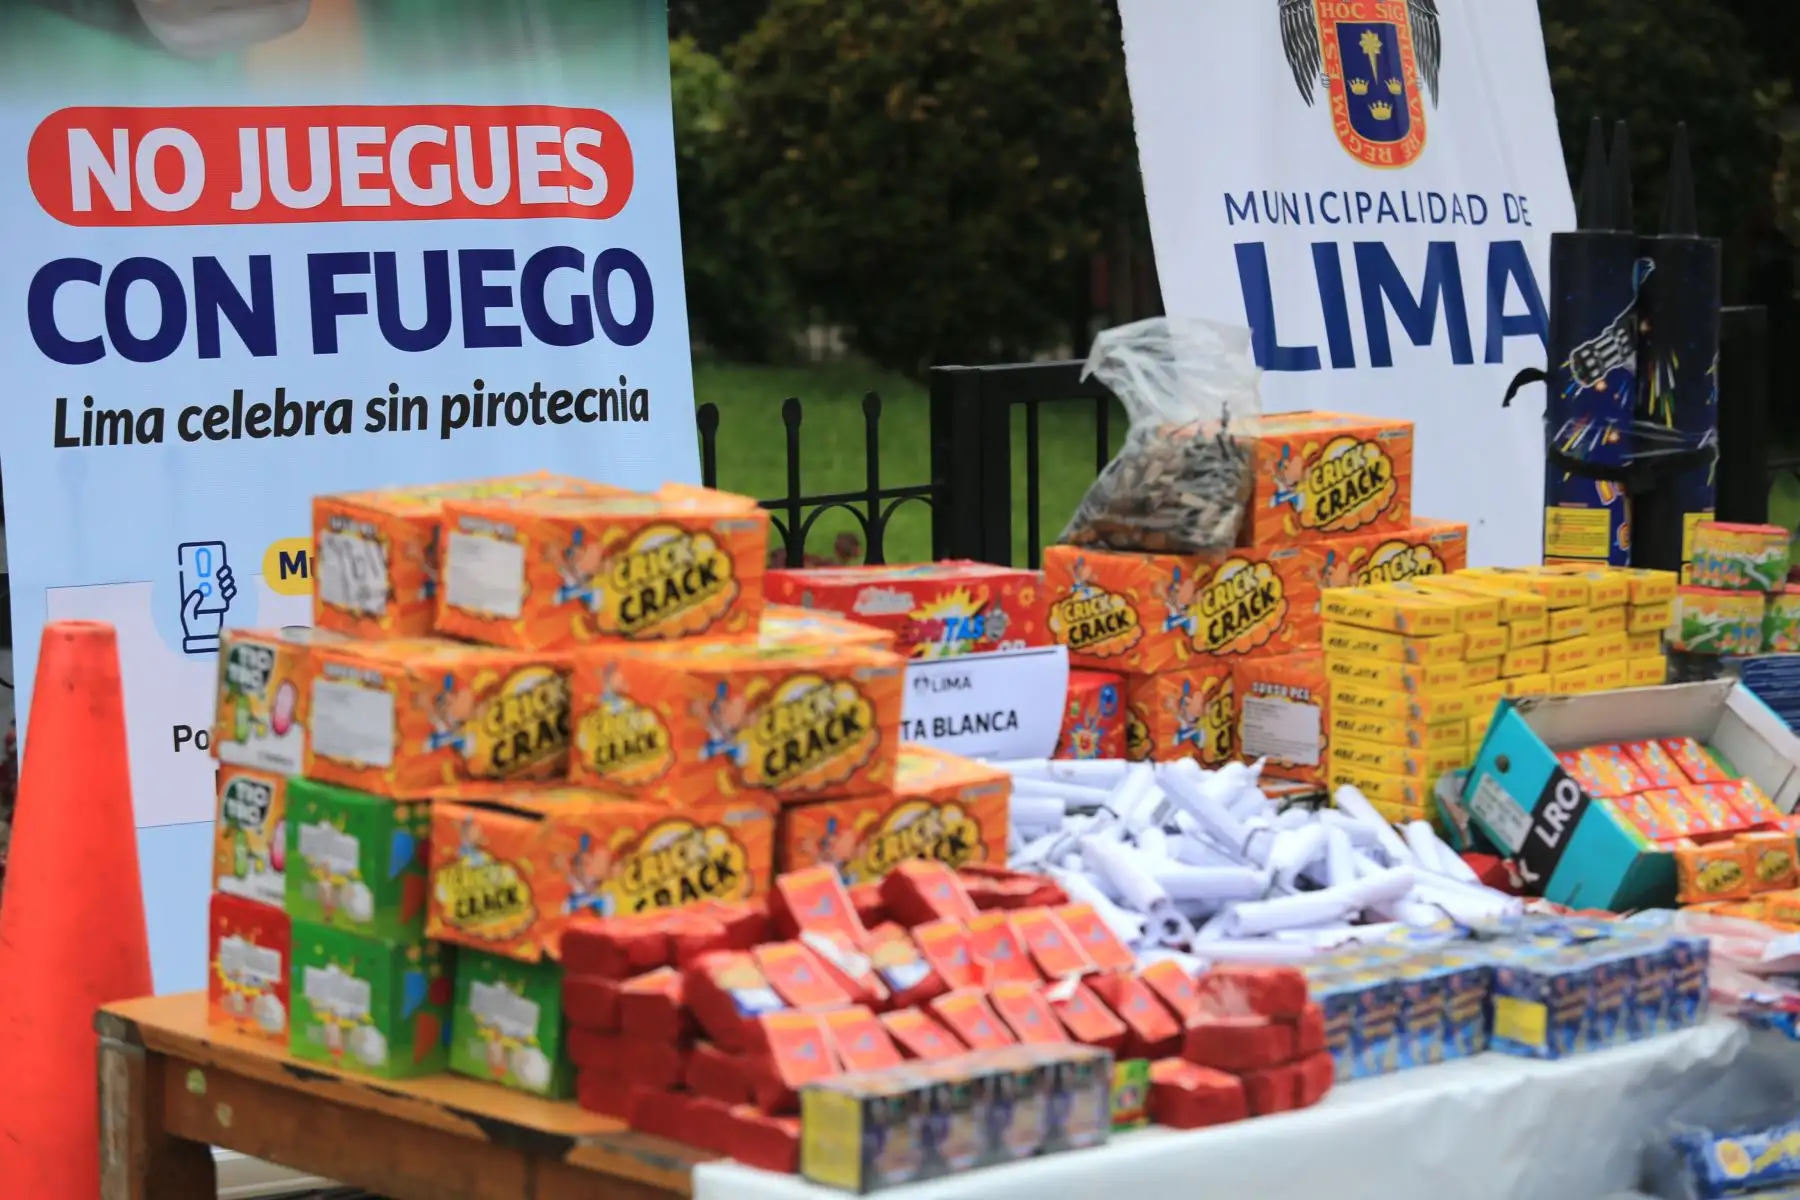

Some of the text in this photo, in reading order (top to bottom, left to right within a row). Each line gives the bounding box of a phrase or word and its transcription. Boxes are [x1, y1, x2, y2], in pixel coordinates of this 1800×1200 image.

[1320, 2, 1367, 19] HOC
[67, 124, 609, 212] NO JUEGUES
[1224, 190, 1533, 227] MUNICIPALIDAD DE
[27, 245, 655, 365] CON FUEGO
[1233, 239, 1549, 372] LIMA
[54, 375, 650, 448] Lima celebra sin pirotecnia
[1307, 441, 1368, 495] CRICK
[1315, 460, 1386, 522] CRACK
[619, 556, 720, 624] CRACK
[1201, 563, 1260, 617] CRICK
[1207, 579, 1277, 645] CRACK
[1067, 609, 1132, 646] CRACK
[931, 676, 973, 694] LIMA
[763, 705, 864, 777] CRACK
[932, 710, 1019, 738] BLANCA
[1535, 777, 1582, 849] LRO
